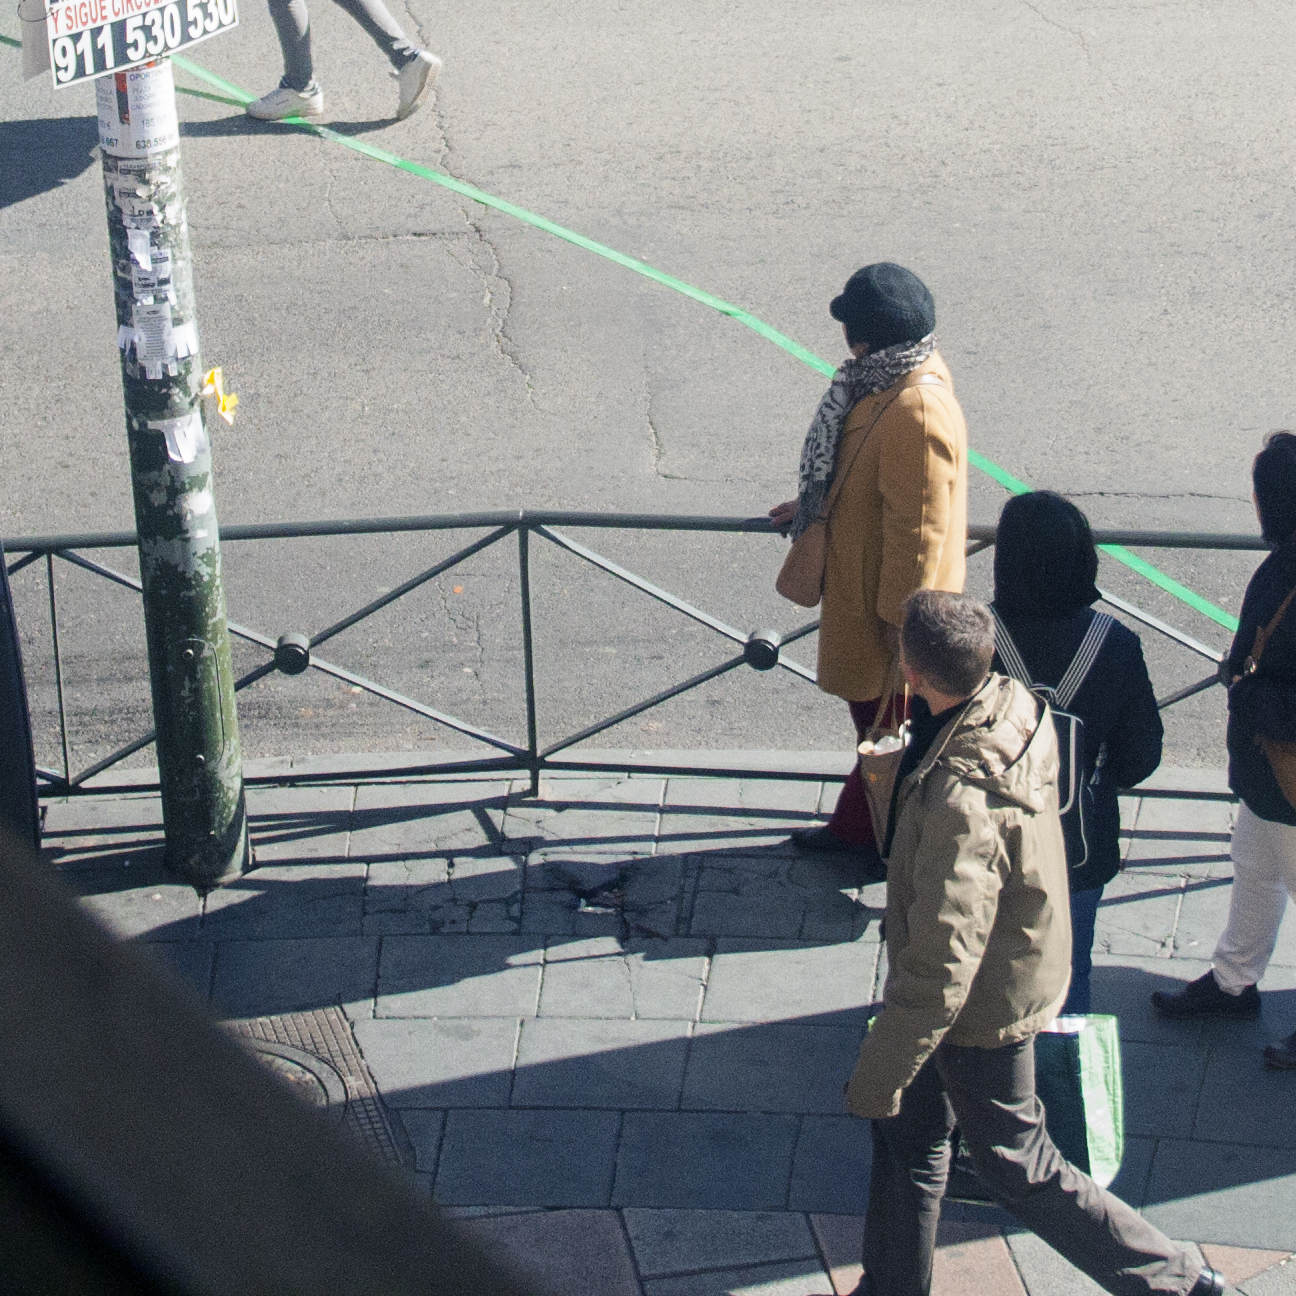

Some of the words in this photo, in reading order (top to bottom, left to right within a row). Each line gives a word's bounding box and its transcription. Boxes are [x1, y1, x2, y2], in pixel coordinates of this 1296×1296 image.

[51, 7, 61, 34] Y
[54, 23, 115, 83] 911
[126, 4, 182, 61] 530
